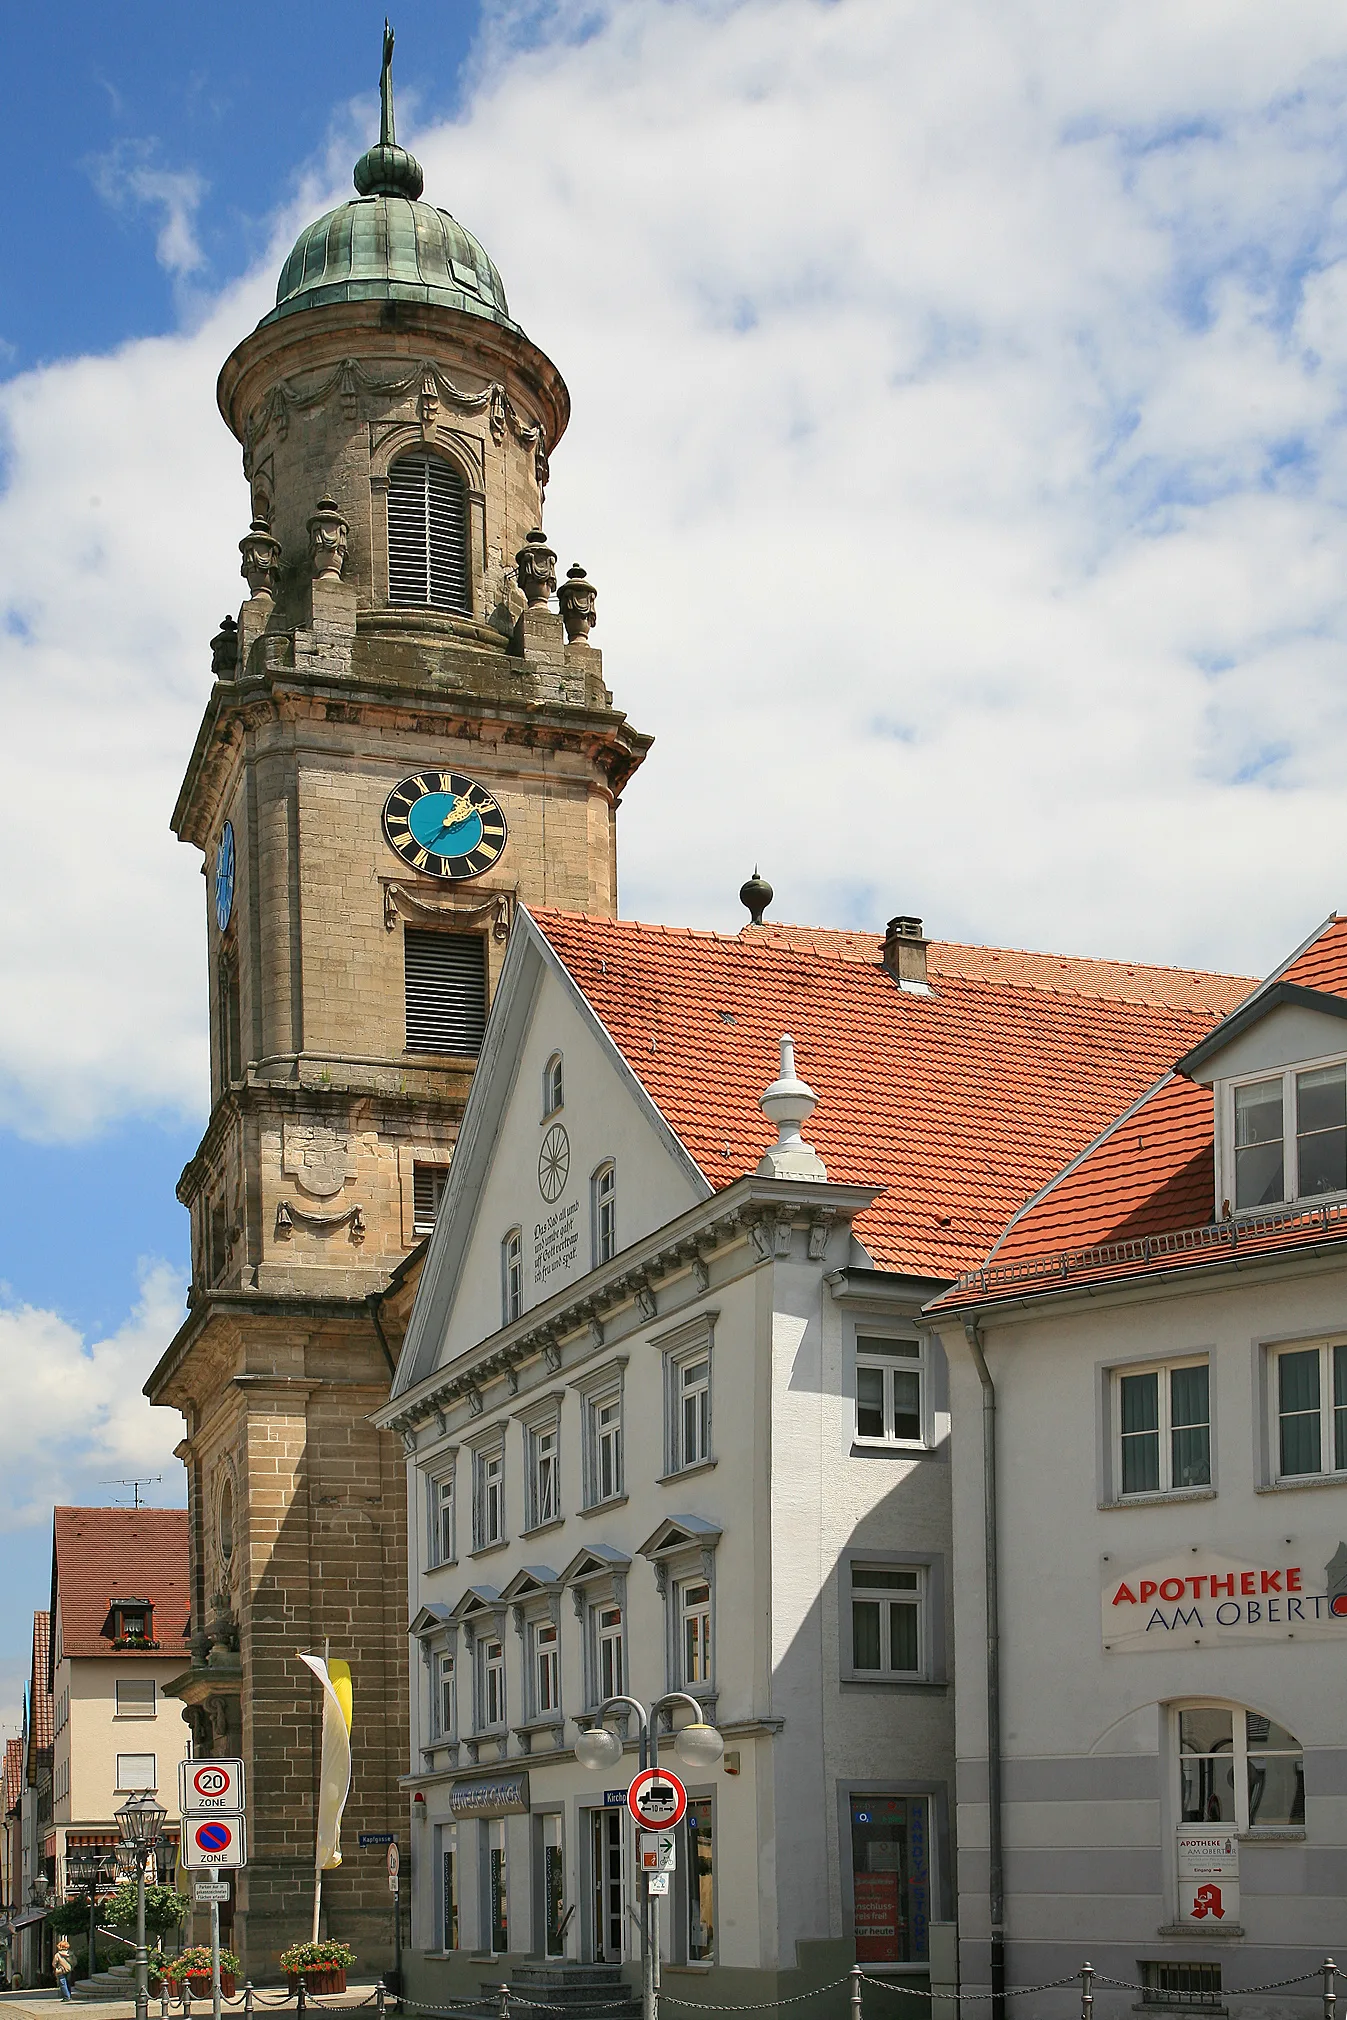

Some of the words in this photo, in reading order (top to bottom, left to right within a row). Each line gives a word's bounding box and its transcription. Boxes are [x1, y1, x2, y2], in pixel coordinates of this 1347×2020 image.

[438, 774, 452, 792] XII
[393, 790, 414, 806] X
[465, 856, 478, 874] V
[1112, 1567, 1302, 1606] APOTHEKE
[1146, 1606, 1204, 1631] AM
[202, 1775, 223, 1789] 20
[198, 1799, 226, 1807] ZONE
[451, 1786, 490, 1811] JUWELIER
[651, 1804, 659, 1812] 10
[200, 1854, 228, 1862] ZONE
[869, 1927, 894, 1935] heute
